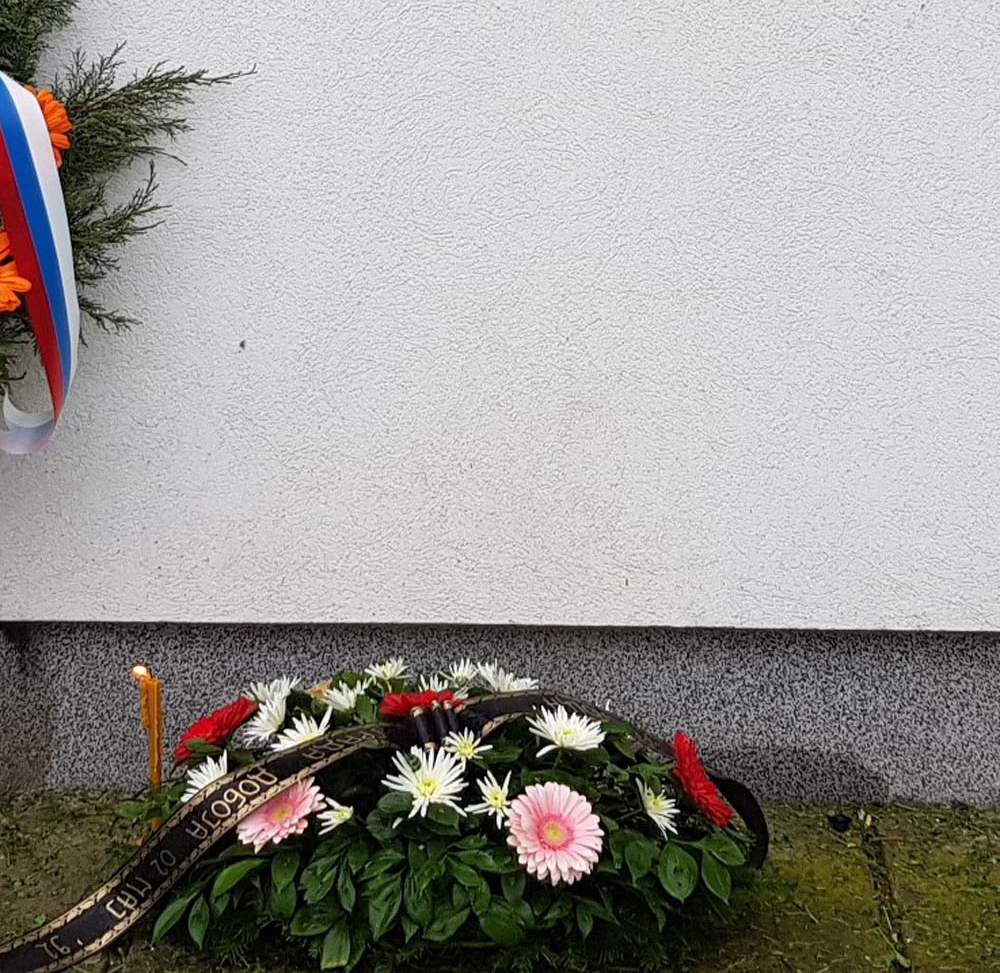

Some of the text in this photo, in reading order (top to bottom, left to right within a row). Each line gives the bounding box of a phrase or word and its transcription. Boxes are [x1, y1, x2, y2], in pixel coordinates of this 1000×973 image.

[186, 768, 278, 839] ДОБОЈА
[150, 849, 176, 876] 02
[106, 875, 152, 919] МАЈ
